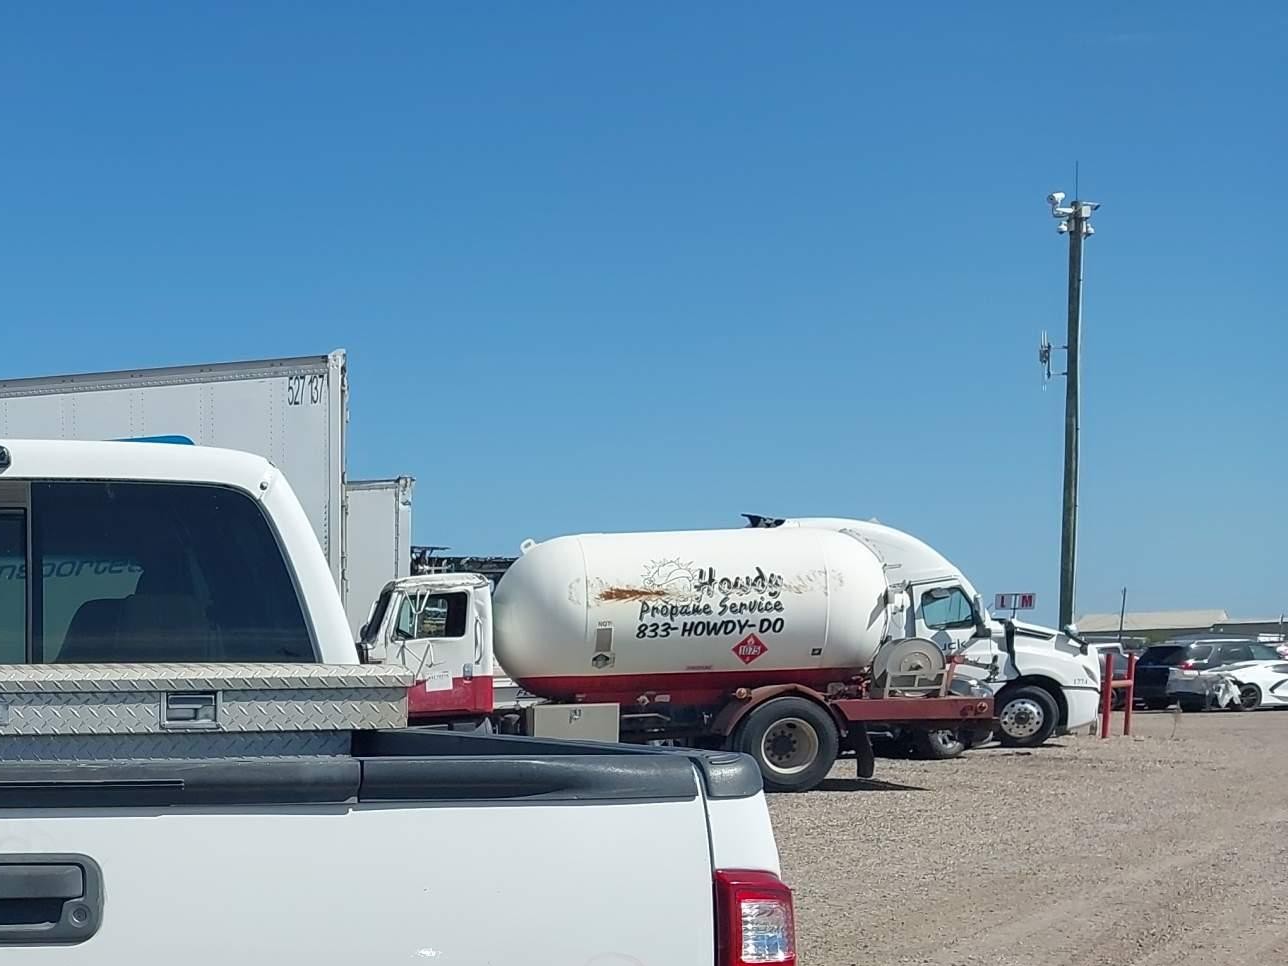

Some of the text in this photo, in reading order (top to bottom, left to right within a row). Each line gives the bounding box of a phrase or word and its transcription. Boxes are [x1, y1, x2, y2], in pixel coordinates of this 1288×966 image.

[287, 374, 325, 406] 527 137
[693, 566, 784, 601] Howdy
[638, 596, 785, 622] Propane Service
[636, 617, 785, 639] 833-HOWDY-DO
[740, 645, 760, 655] 1075
